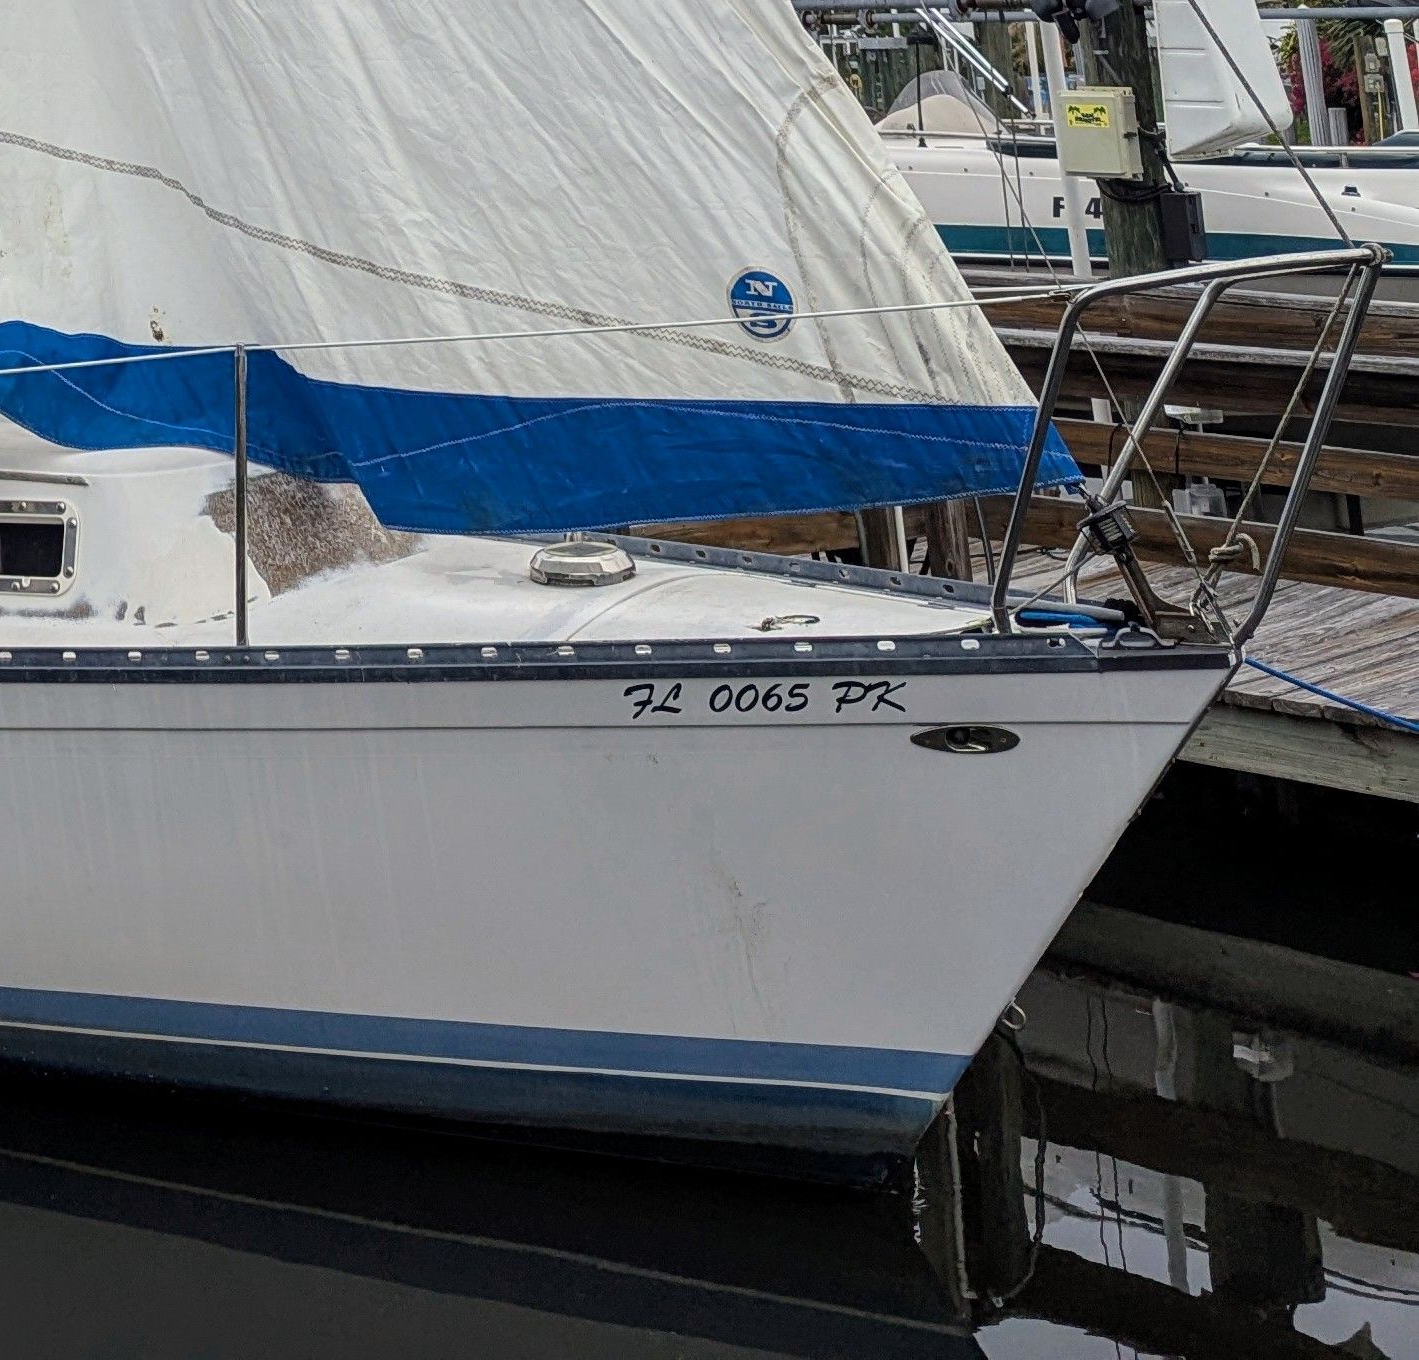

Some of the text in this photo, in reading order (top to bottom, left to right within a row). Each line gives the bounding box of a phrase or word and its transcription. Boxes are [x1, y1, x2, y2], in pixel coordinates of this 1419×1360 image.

[624, 681, 906, 719] FL 0065 PK
